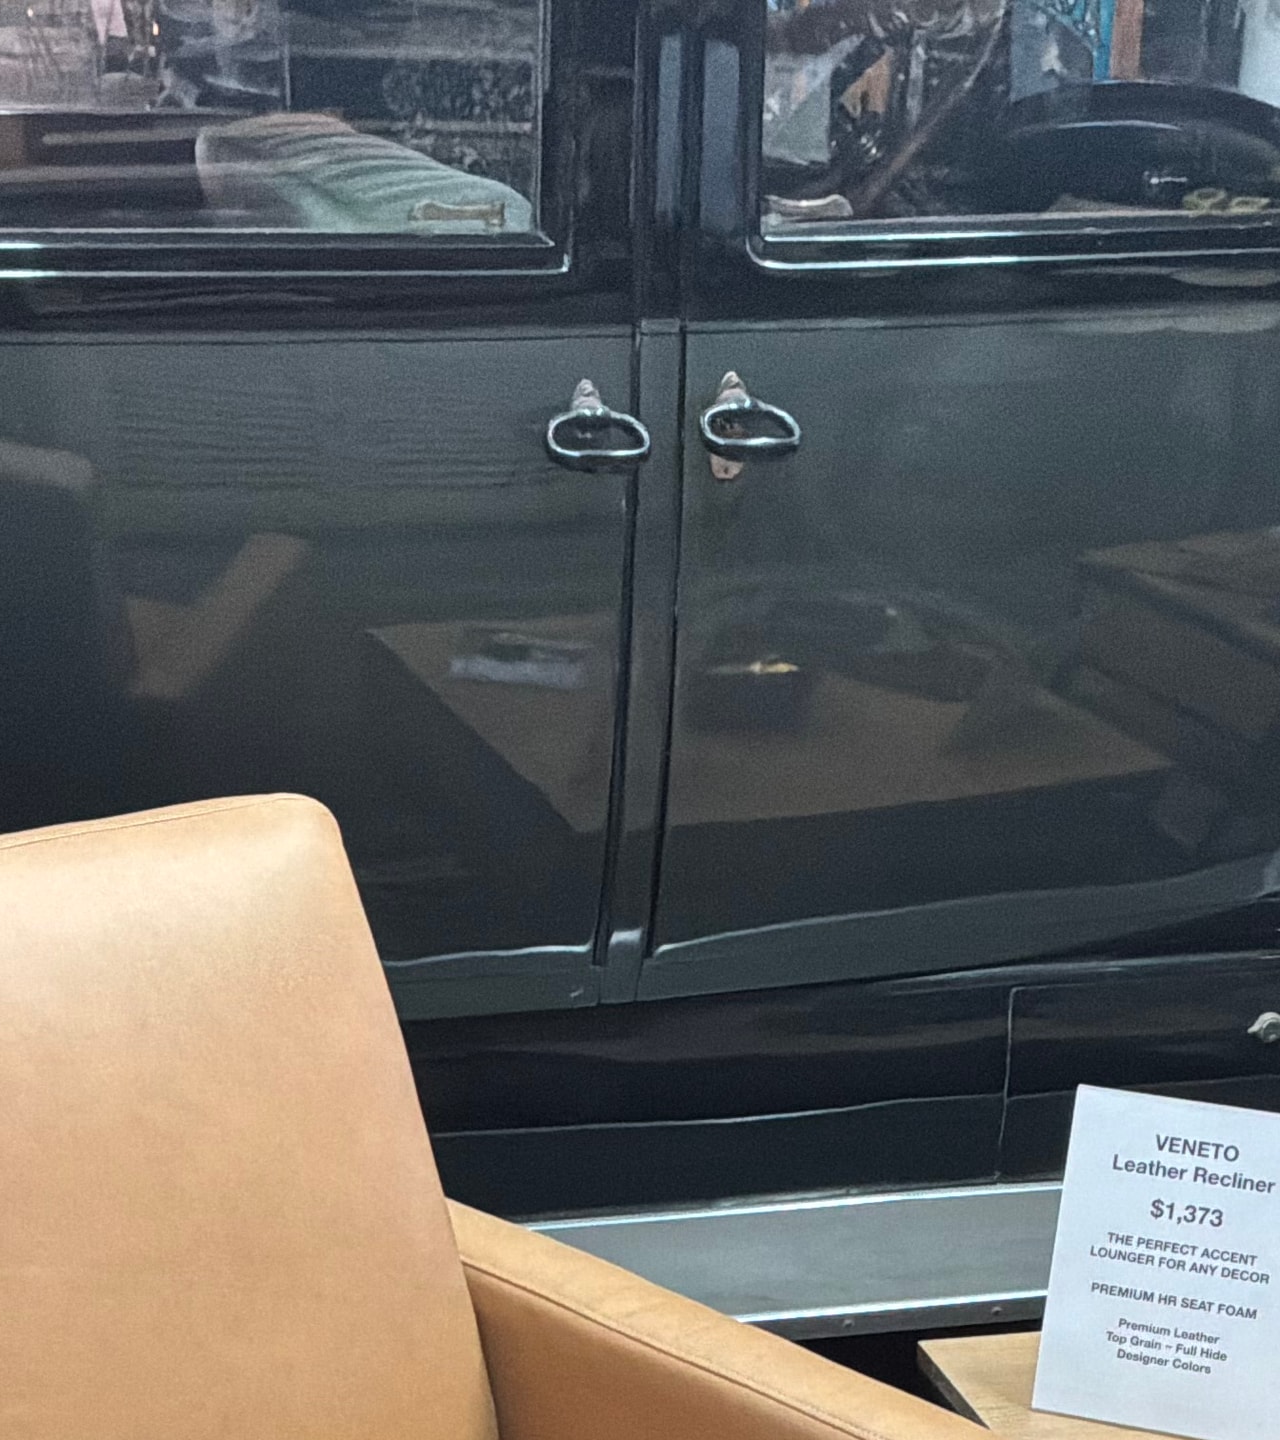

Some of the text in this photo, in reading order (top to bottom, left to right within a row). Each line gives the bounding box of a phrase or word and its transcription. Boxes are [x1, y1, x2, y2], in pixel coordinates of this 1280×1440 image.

[1155, 1134, 1240, 1163] VENETO
[1112, 1154, 1276, 1194] Leather Recliner
[1150, 1199, 1224, 1228] $1,373
[1107, 1232, 1258, 1266] THE PERFECT ACCENT
[1090, 1245, 1270, 1285] LOUNGER FOR ANY DECOR
[1091, 1282, 1258, 1320] PREMIUM HR SEAT FOAM
[1106, 1331, 1128, 1349] Top
[1130, 1335, 1162, 1351] Grain
[1175, 1343, 1197, 1357] Full
[1200, 1347, 1228, 1361] Hide
[1118, 1318, 1220, 1345] Premium Leather
[1116, 1348, 1211, 1374] Designer Colors
